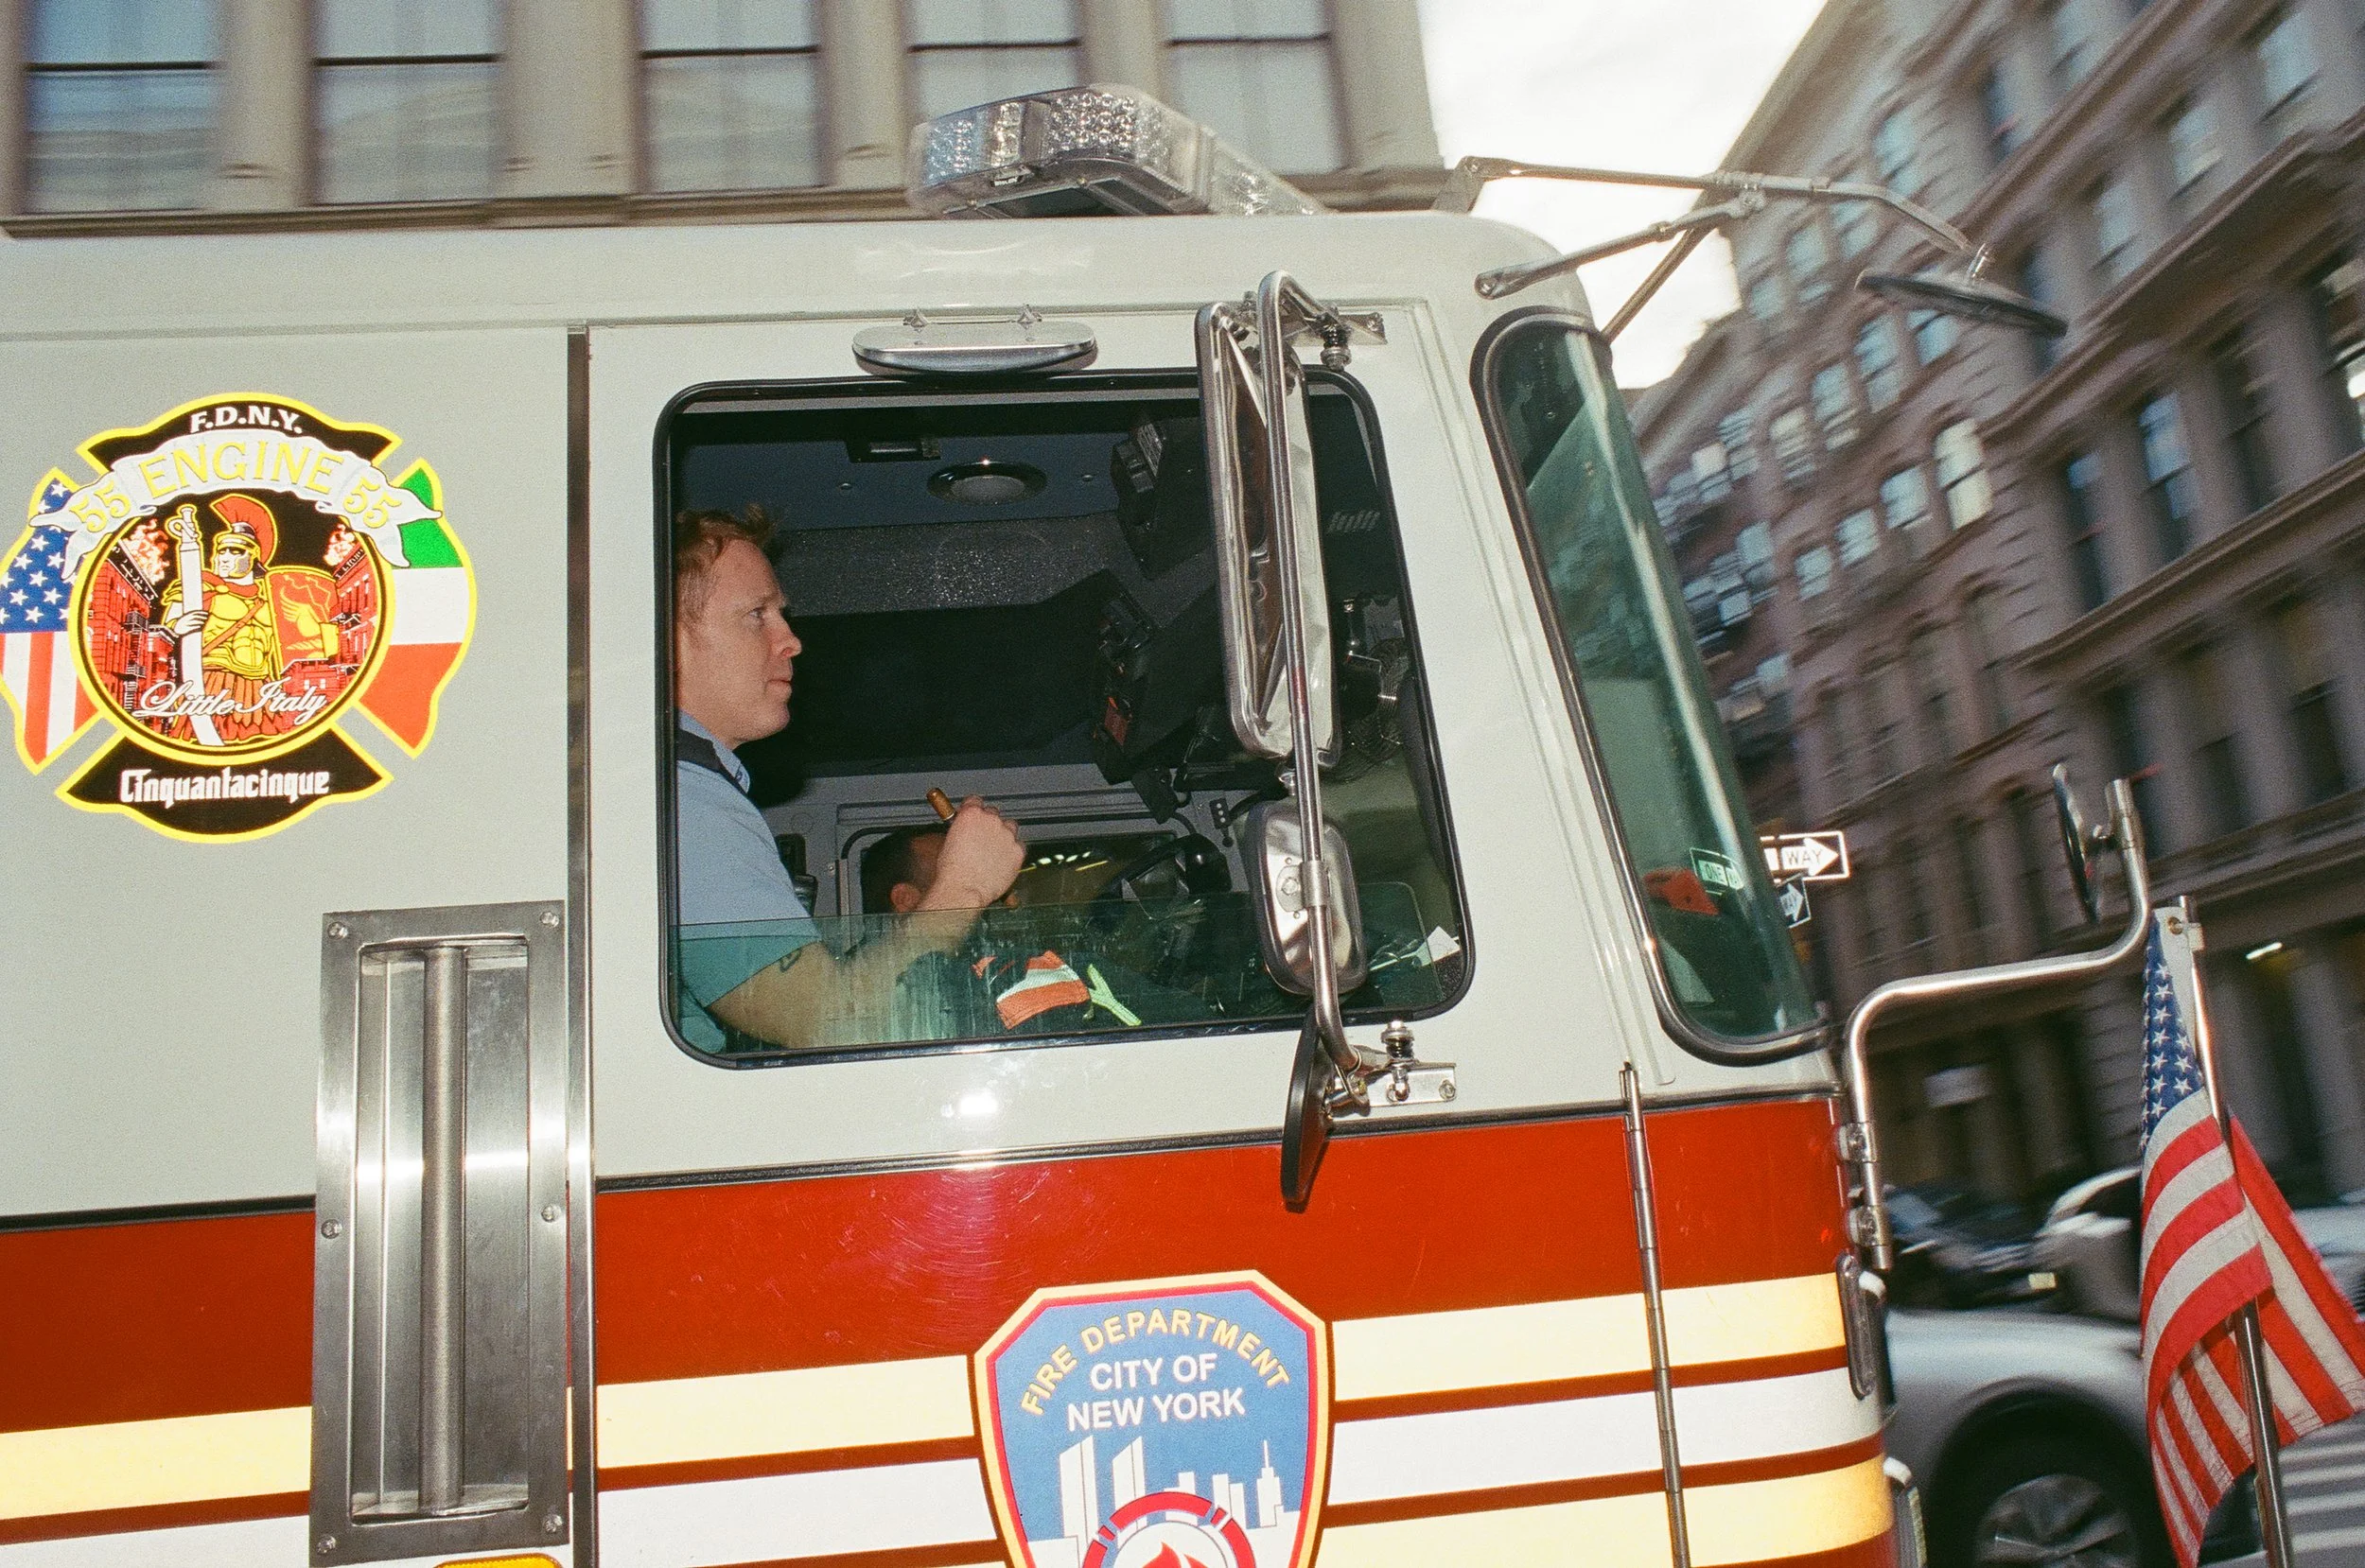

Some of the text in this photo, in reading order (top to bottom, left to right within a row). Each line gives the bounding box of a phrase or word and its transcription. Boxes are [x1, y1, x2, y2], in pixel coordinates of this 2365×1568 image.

[190, 405, 303, 435] F.D.N.Y.
[70, 441, 403, 534] 55 ENGINE 55
[132, 677, 327, 724] Little Italy
[120, 765, 330, 809] Cinquantacinque
[1787, 852, 1822, 865] WAY
[1020, 1307, 1291, 1416] FIRE DEPARTMENT
[1090, 1352, 1218, 1391] CITY OF
[1067, 1387, 1247, 1432] NEW YORK
